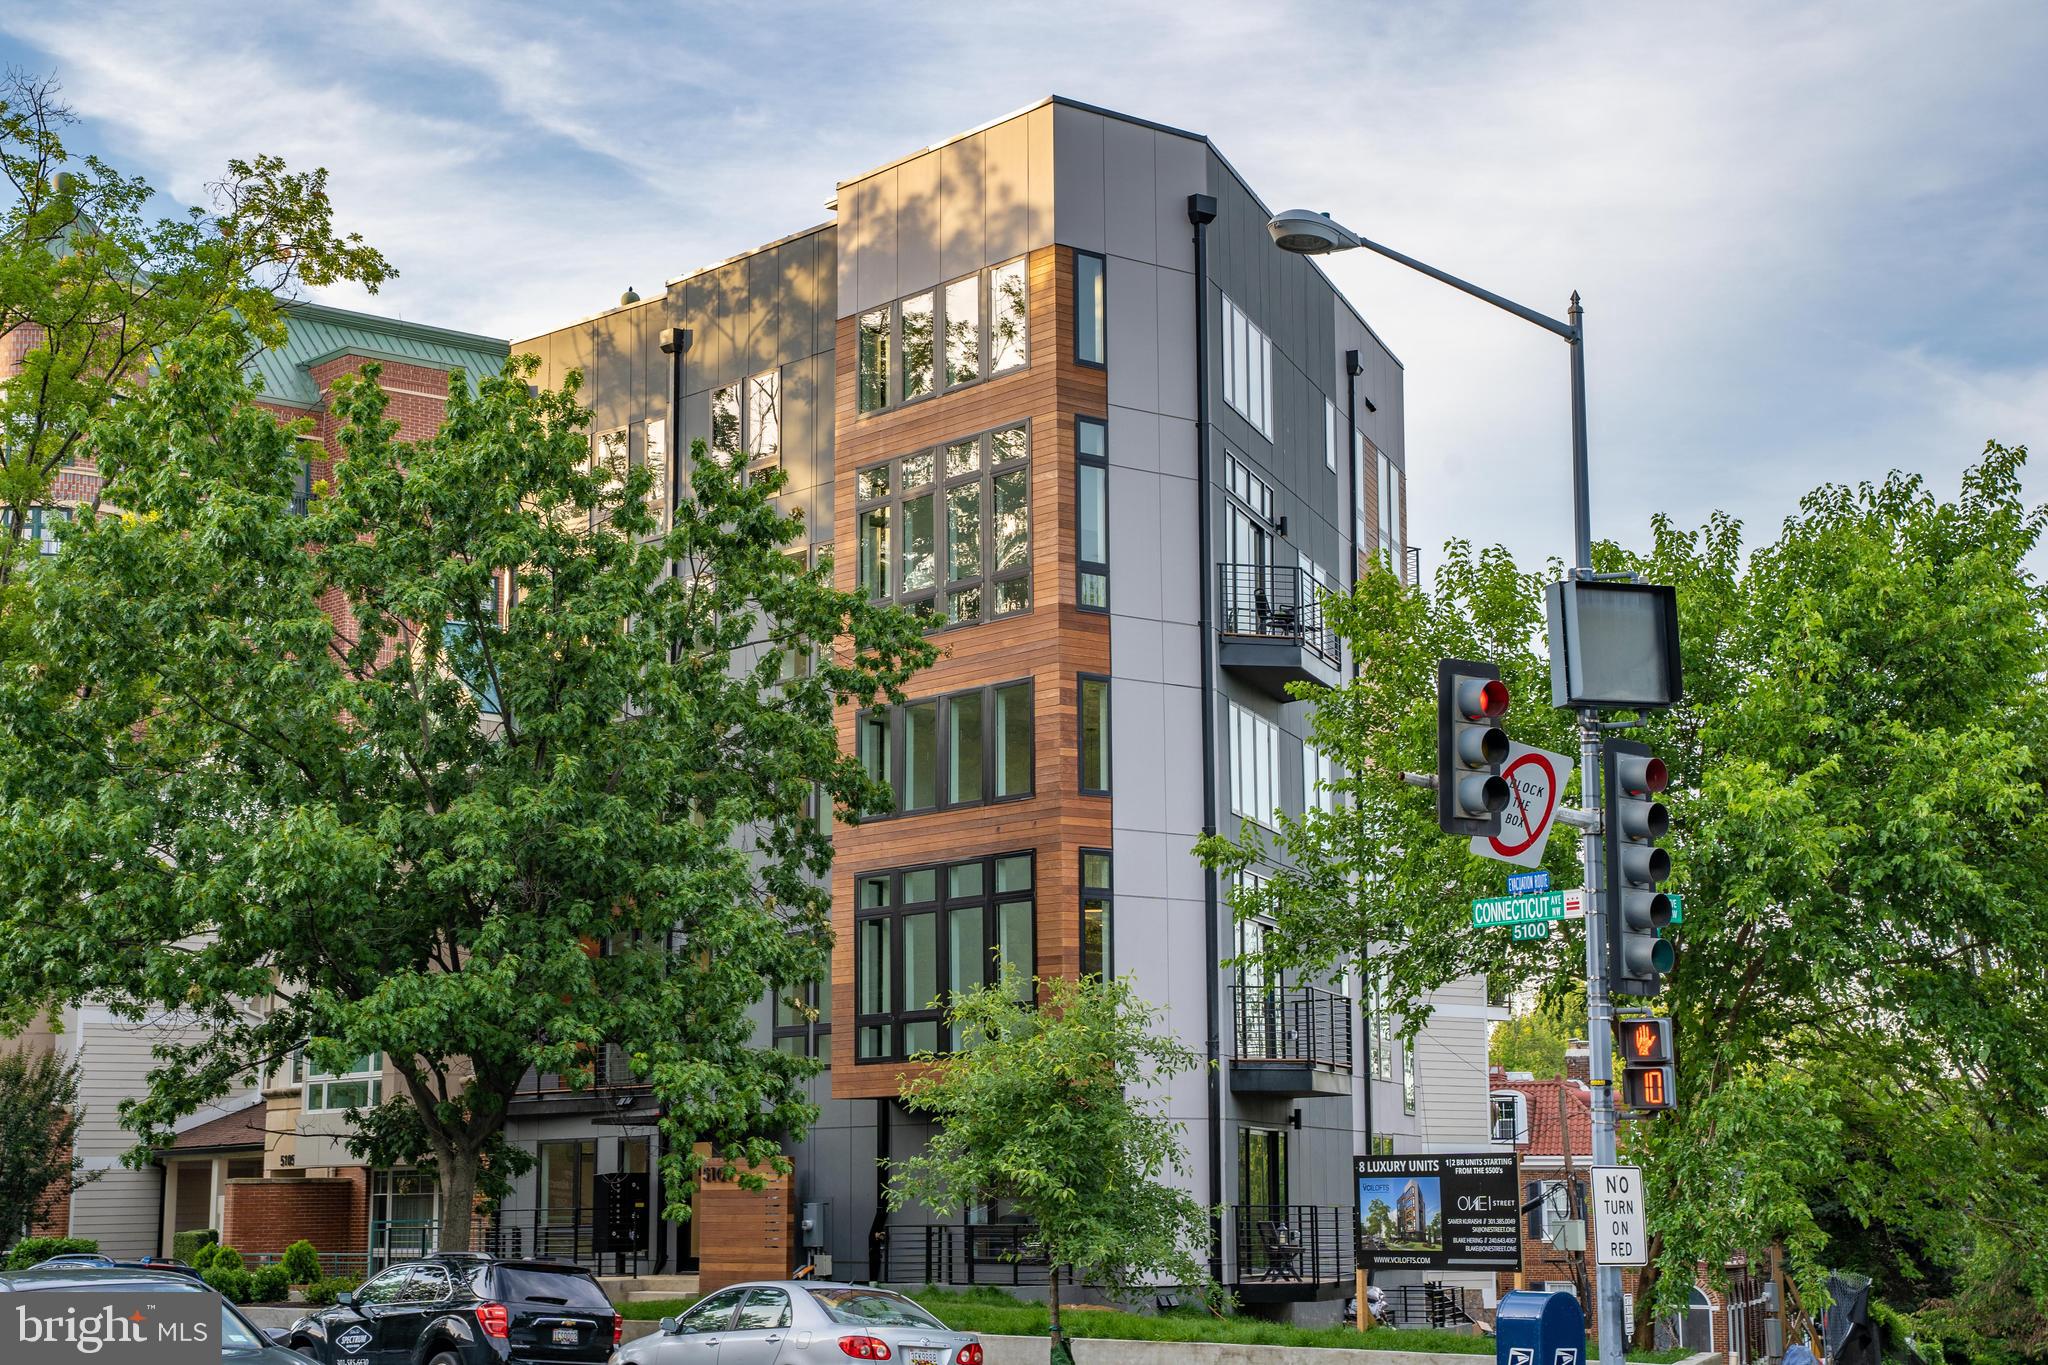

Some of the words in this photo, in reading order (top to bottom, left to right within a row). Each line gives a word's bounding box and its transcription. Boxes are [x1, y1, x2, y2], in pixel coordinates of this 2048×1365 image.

[1513, 796, 1531, 812] THE
[1505, 813, 1524, 828] BOX
[1475, 896, 1549, 924] CONNECTICUT
[1551, 894, 1562, 905] AVE
[1552, 907, 1561, 916] NW
[1514, 922, 1546, 939] 5100
[1644, 1071, 1663, 1104] 10
[1358, 1161, 1365, 1172] 8
[1367, 1160, 1406, 1173] LUXURY
[1408, 1160, 1440, 1172] UNITS
[1465, 1158, 1483, 1166] UNITS
[1483, 1158, 1513, 1166] STARTING
[1606, 1176, 1629, 1194] NO
[1604, 1200, 1634, 1215] TURN
[1612, 1221, 1629, 1236] ON
[1611, 1242, 1632, 1257] RED
